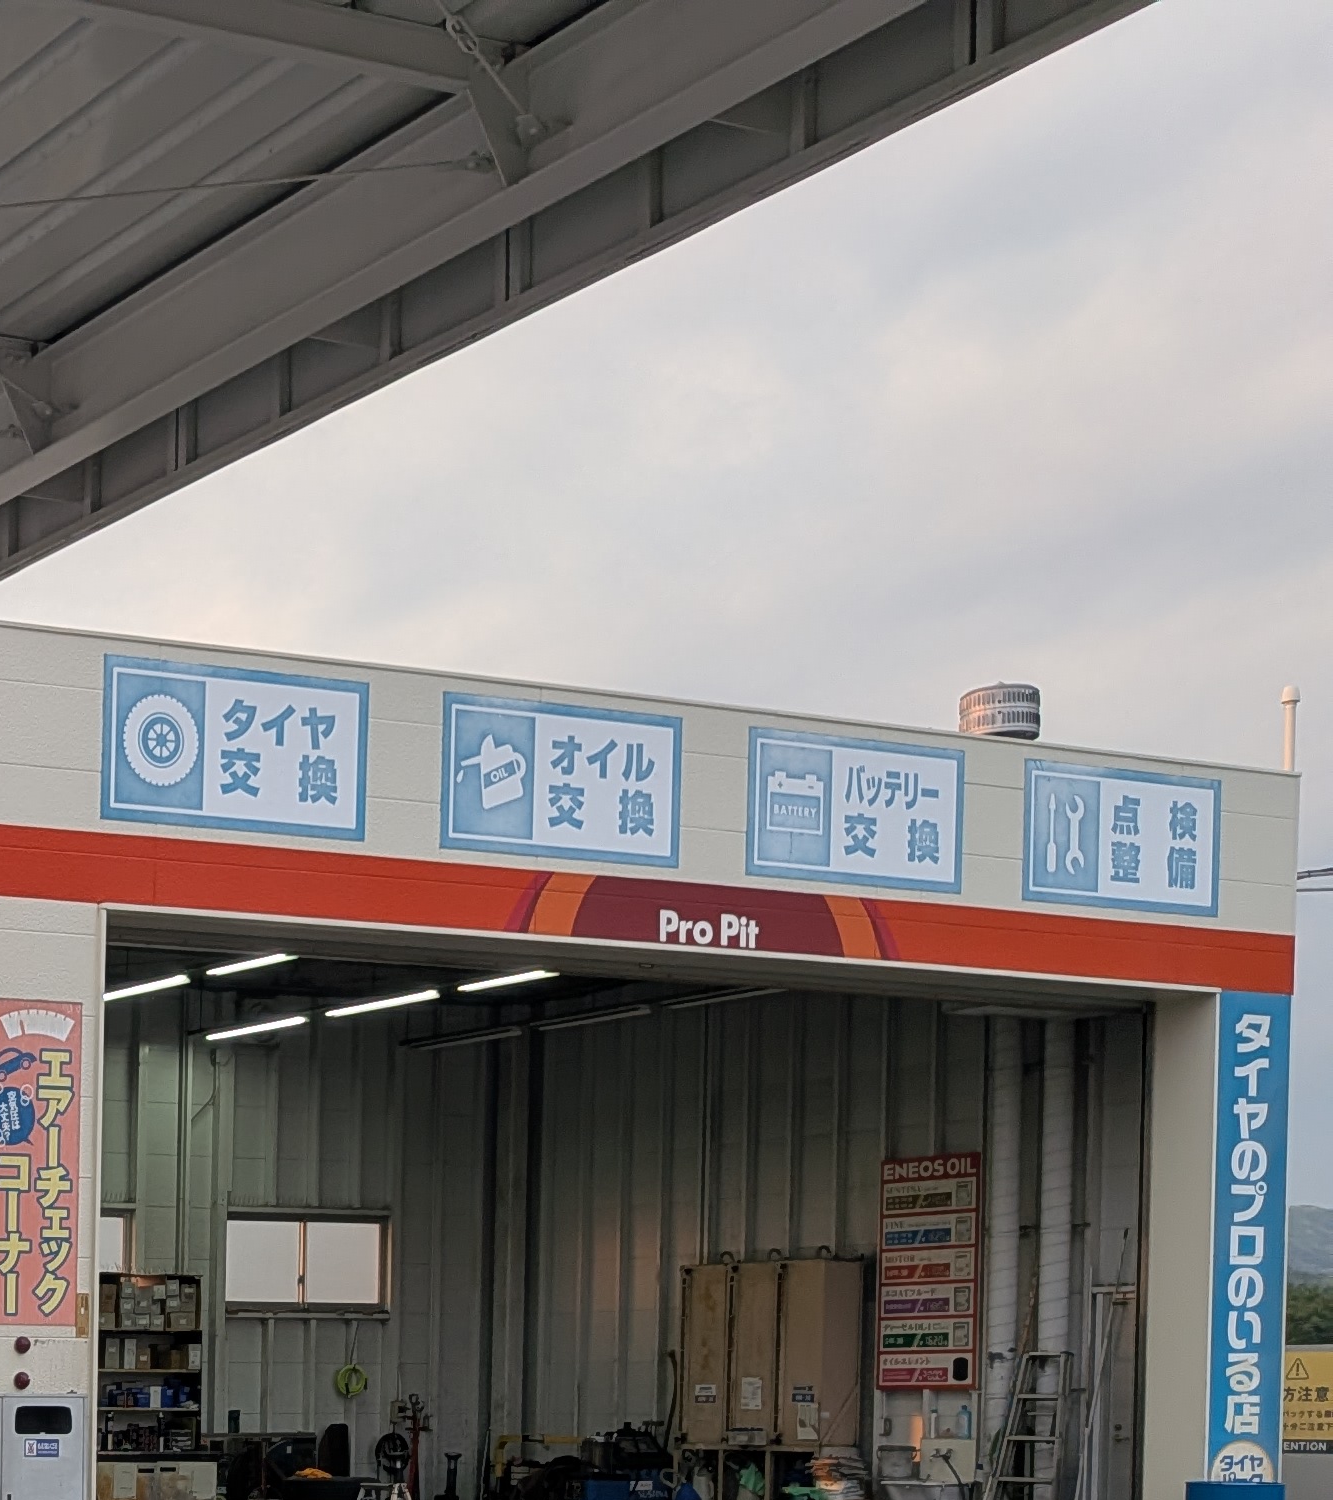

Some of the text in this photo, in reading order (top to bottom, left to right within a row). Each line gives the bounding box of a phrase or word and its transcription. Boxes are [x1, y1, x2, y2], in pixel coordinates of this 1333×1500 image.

[222, 699, 336, 750] タイヤ
[219, 747, 338, 806] 交換
[490, 769, 510, 783] OIL
[550, 735, 655, 782] オイル
[547, 782, 655, 837] 交換
[773, 803, 818, 818] BATTERY
[844, 765, 939, 811] バッテリー
[843, 812, 939, 865] 交換
[1111, 794, 1198, 842] 点検
[1110, 840, 1197, 890] 整備
[659, 908, 760, 949] Pro Pit
[33, 1047, 76, 1317] エアーチェック
[883, 1157, 977, 1180] ENEOS OIL
[1224, 1012, 1272, 1435] タイヤのプロのいる店
[1219, 1454, 1264, 1472] タイヤ
